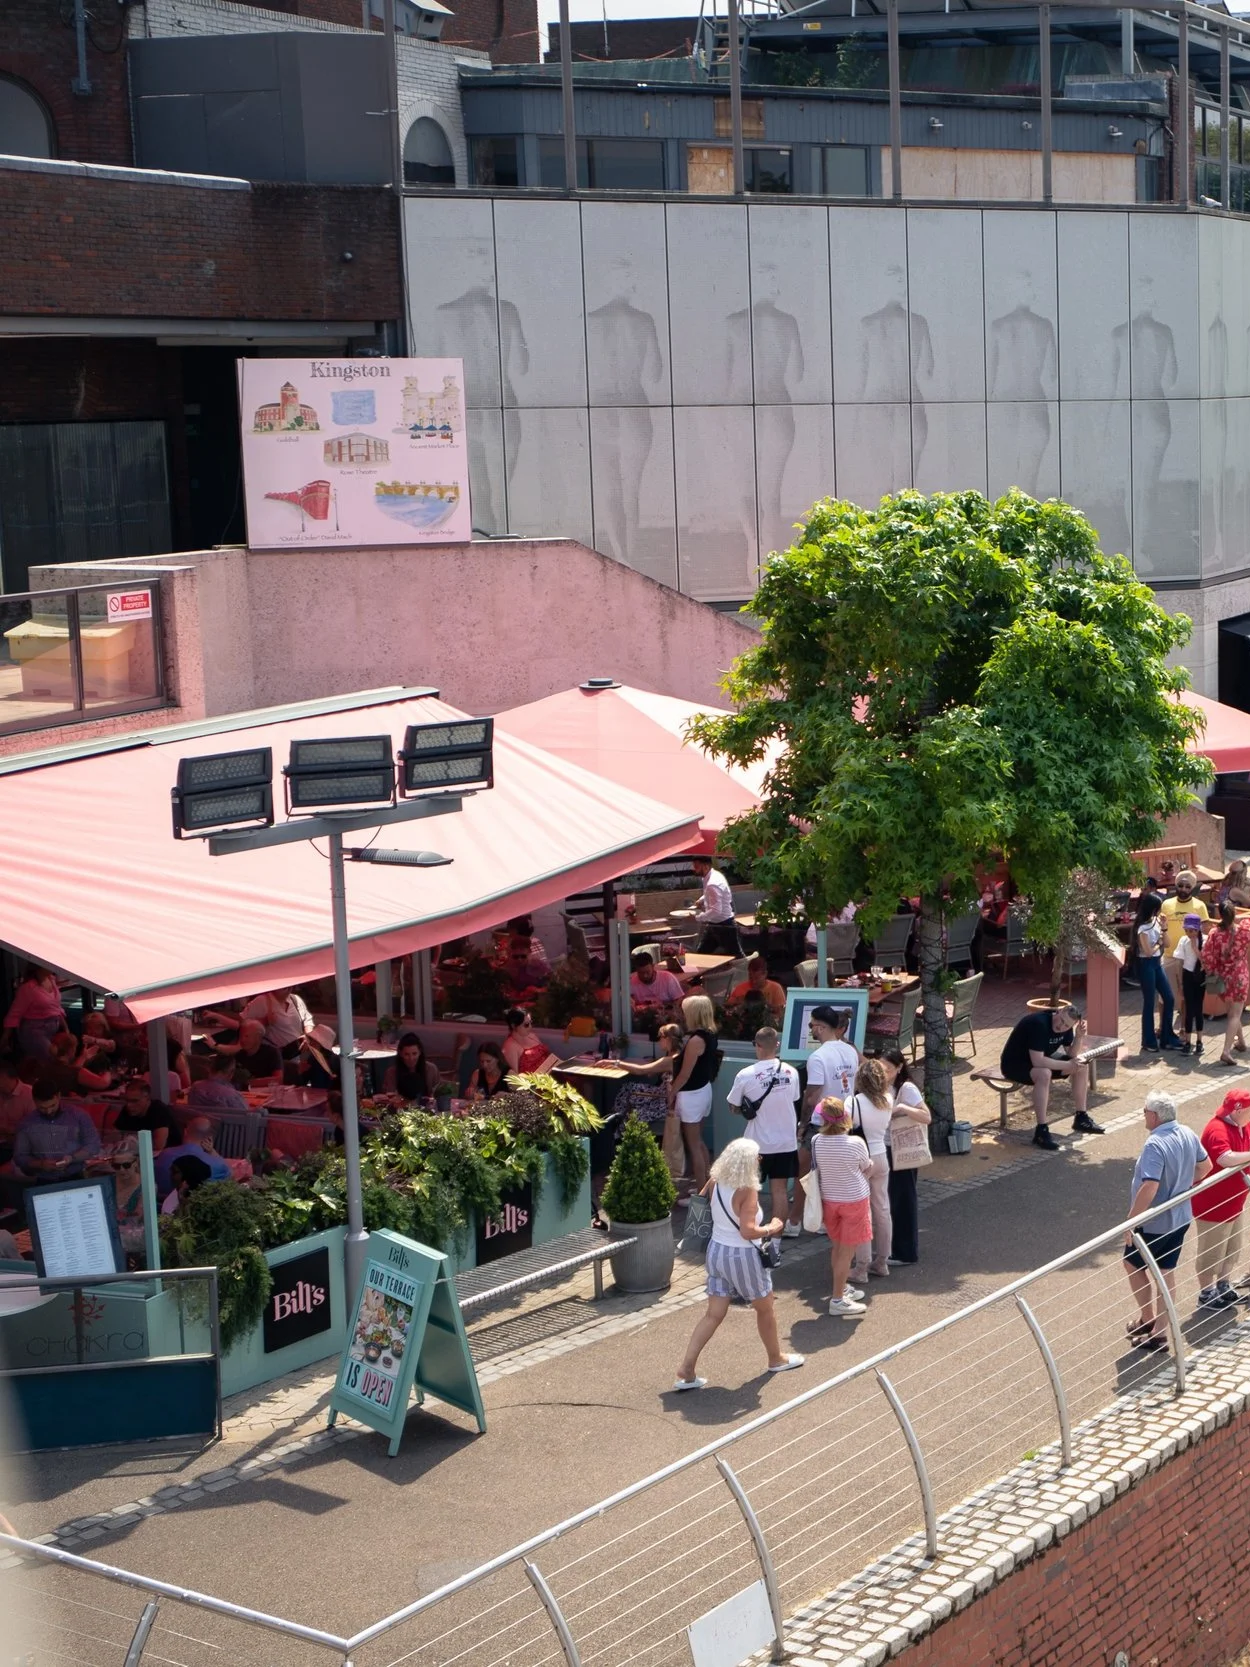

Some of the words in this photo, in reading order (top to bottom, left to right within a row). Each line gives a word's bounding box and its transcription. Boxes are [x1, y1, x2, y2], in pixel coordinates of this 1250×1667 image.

[310, 361, 391, 382] Kingston
[123, 601, 148, 609] PROPERTY
[125, 595, 144, 603] PRIVATE
[388, 1246, 410, 1270] Bill's
[369, 1268, 384, 1287] OUR
[385, 1275, 416, 1301] TERRACE
[273, 1280, 326, 1322] Bill's
[345, 1361, 361, 1388] IS
[361, 1368, 393, 1408] OPEN
